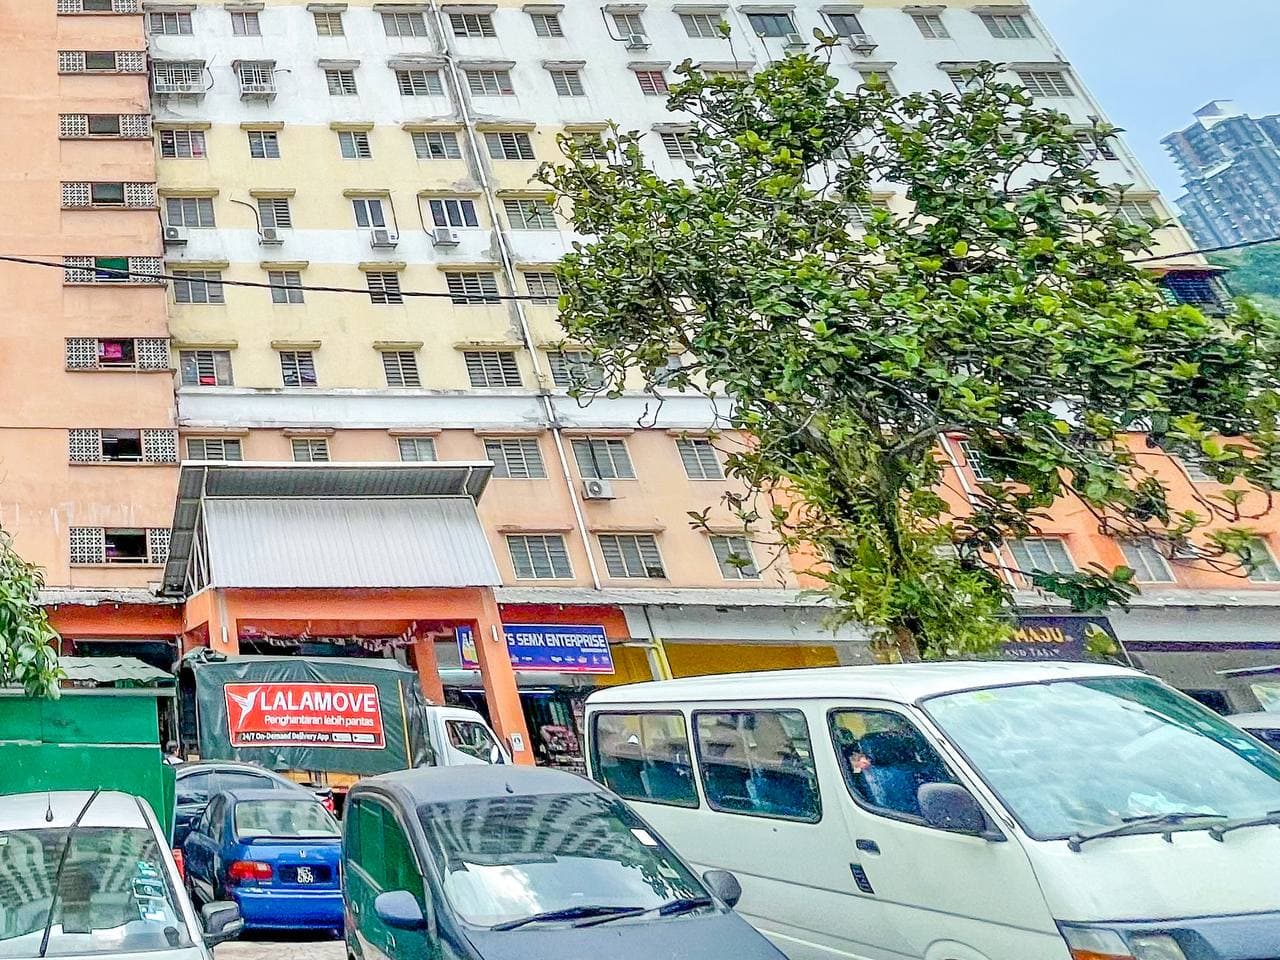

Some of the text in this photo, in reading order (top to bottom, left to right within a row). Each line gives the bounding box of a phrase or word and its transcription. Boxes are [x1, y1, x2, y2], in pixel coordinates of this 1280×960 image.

[518, 633, 544, 646] SEMX
[546, 633, 606, 647] ENTERPRISE
[260, 691, 377, 712] LALAMOVE
[264, 715, 374, 727] Penghantaran lebih pantas
[242, 732, 255, 741] 24/7
[256, 732, 291, 740] On-Demand
[292, 732, 317, 741] Delivery
[317, 734, 330, 742] App
